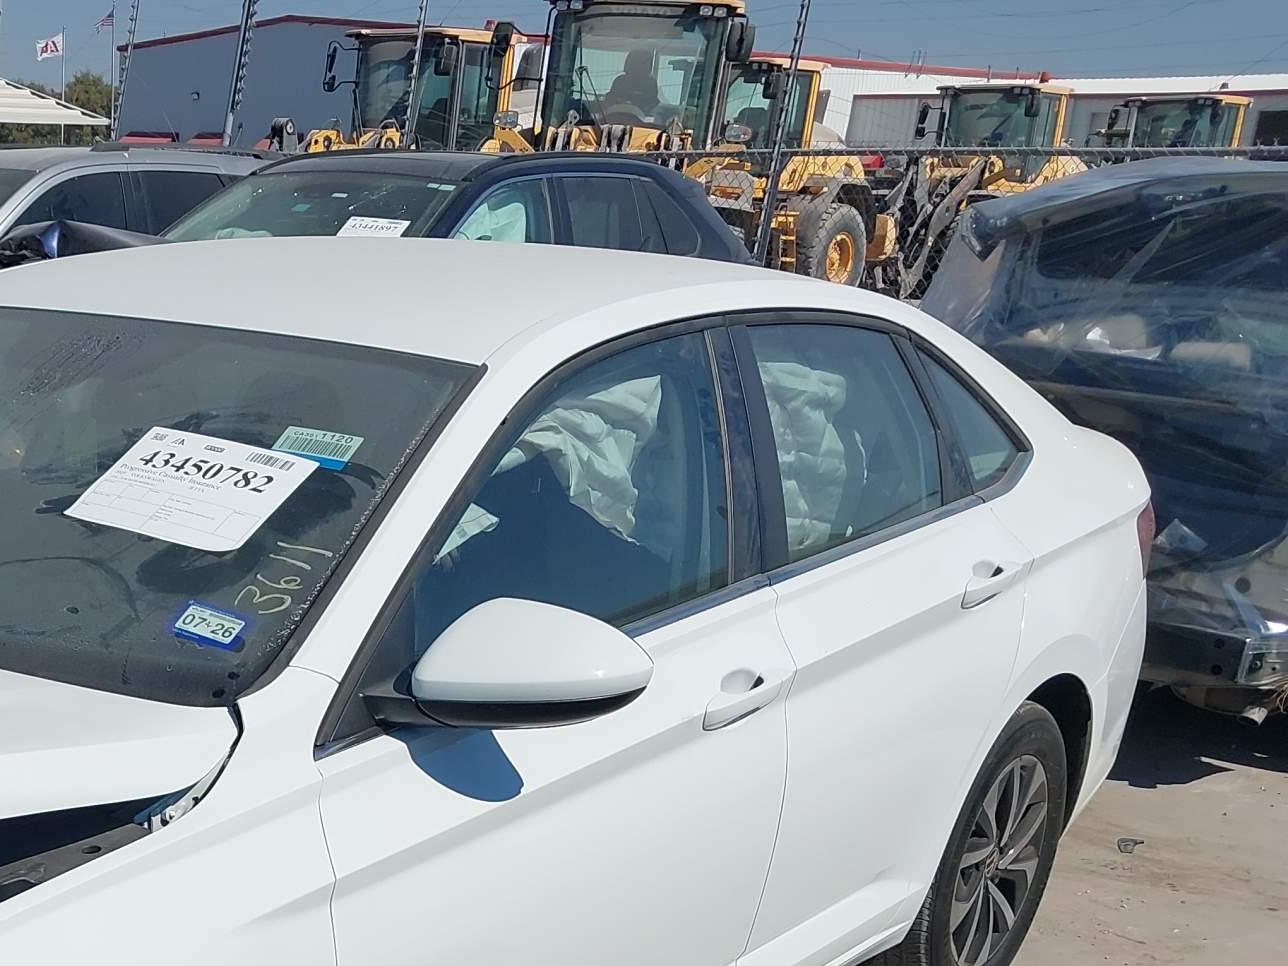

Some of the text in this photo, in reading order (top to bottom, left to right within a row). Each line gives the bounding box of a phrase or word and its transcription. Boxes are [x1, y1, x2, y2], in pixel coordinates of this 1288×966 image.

[320, 432, 354, 444] 1120
[140, 450, 274, 494] 43450782
[234, 541, 333, 615] 3611
[182, 613, 207, 628] 07
[210, 622, 236, 638] 26
